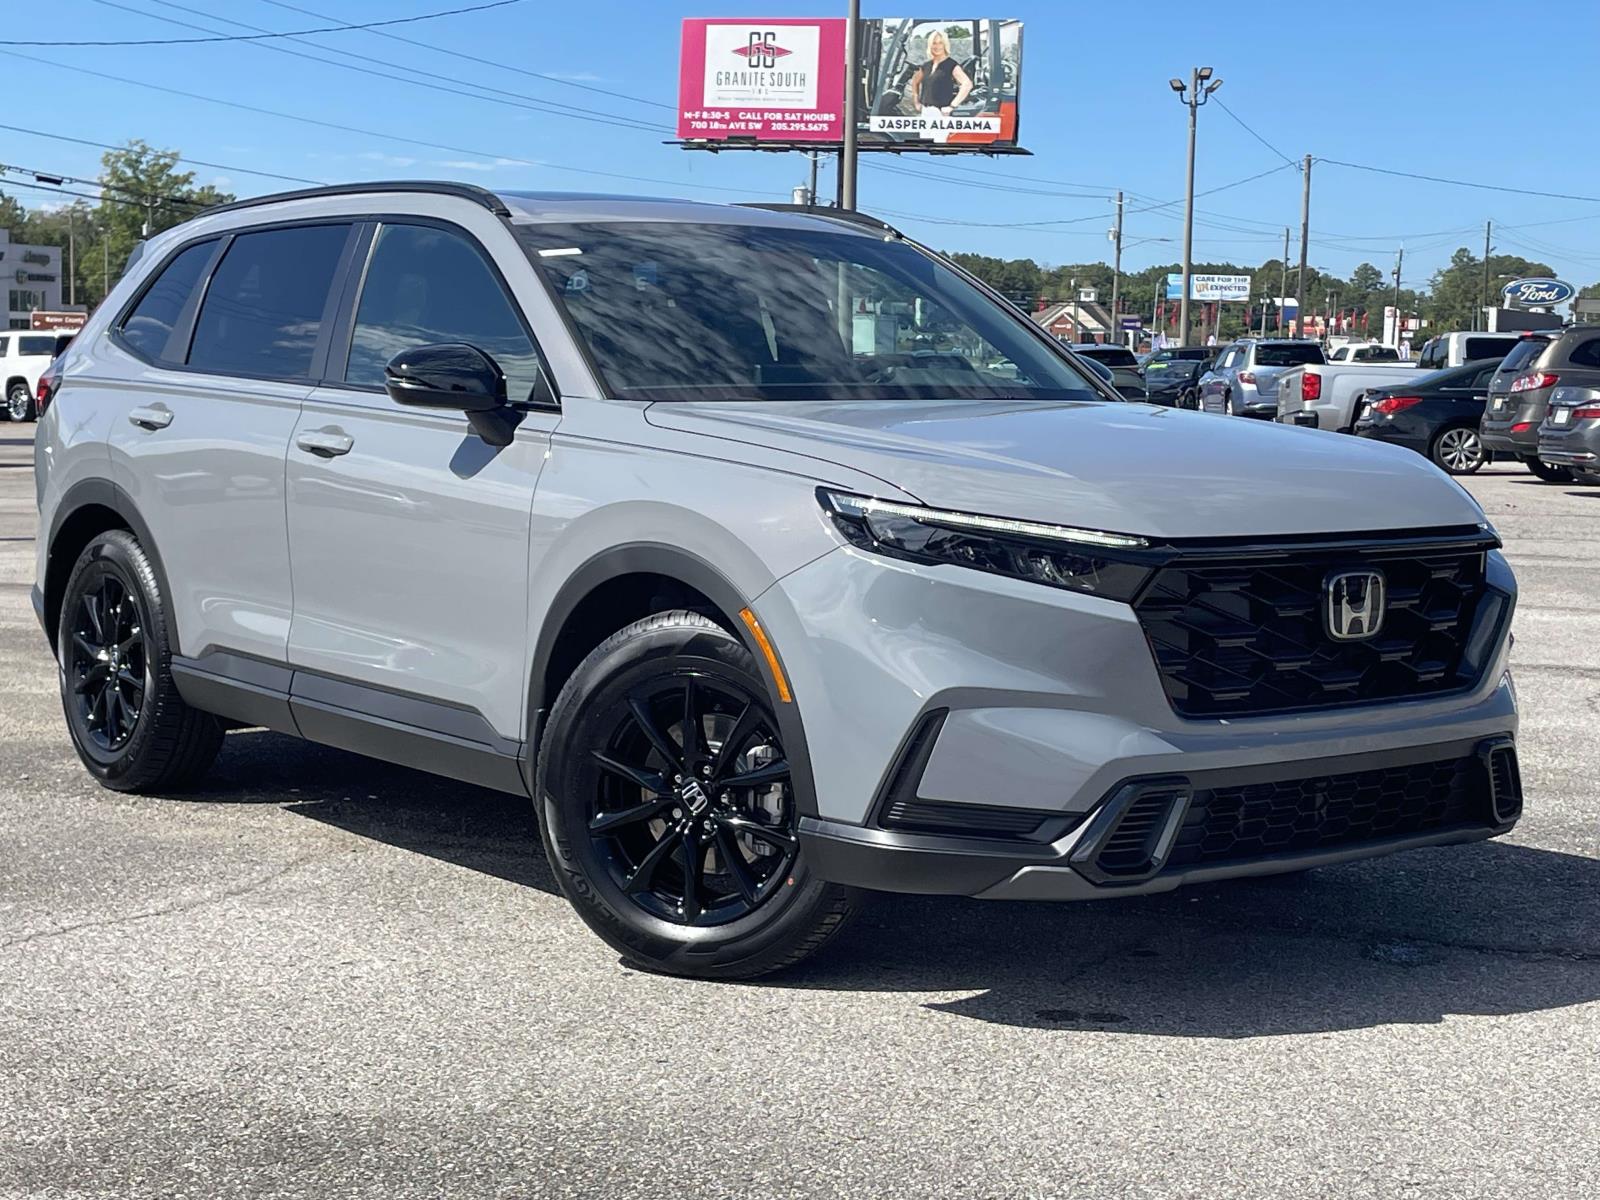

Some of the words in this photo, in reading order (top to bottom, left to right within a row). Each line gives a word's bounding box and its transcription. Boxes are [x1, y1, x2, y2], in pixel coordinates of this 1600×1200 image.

[748, 31, 776, 68] GS
[716, 71, 765, 87] GRANITE
[769, 72, 806, 87] SOUTH
[684, 112, 700, 120] M-F
[702, 112, 730, 120] 8:30-5
[738, 112, 762, 120] CALL
[764, 113, 782, 121] FOR
[784, 113, 801, 121] SAT
[803, 113, 836, 121] HOURS
[691, 121, 708, 129] 700
[728, 122, 747, 130] AVE
[748, 122, 763, 130] SW
[878, 119, 927, 130] JASPER
[930, 120, 992, 130] ALABAMA
[1518, 283, 1560, 301] Ford
